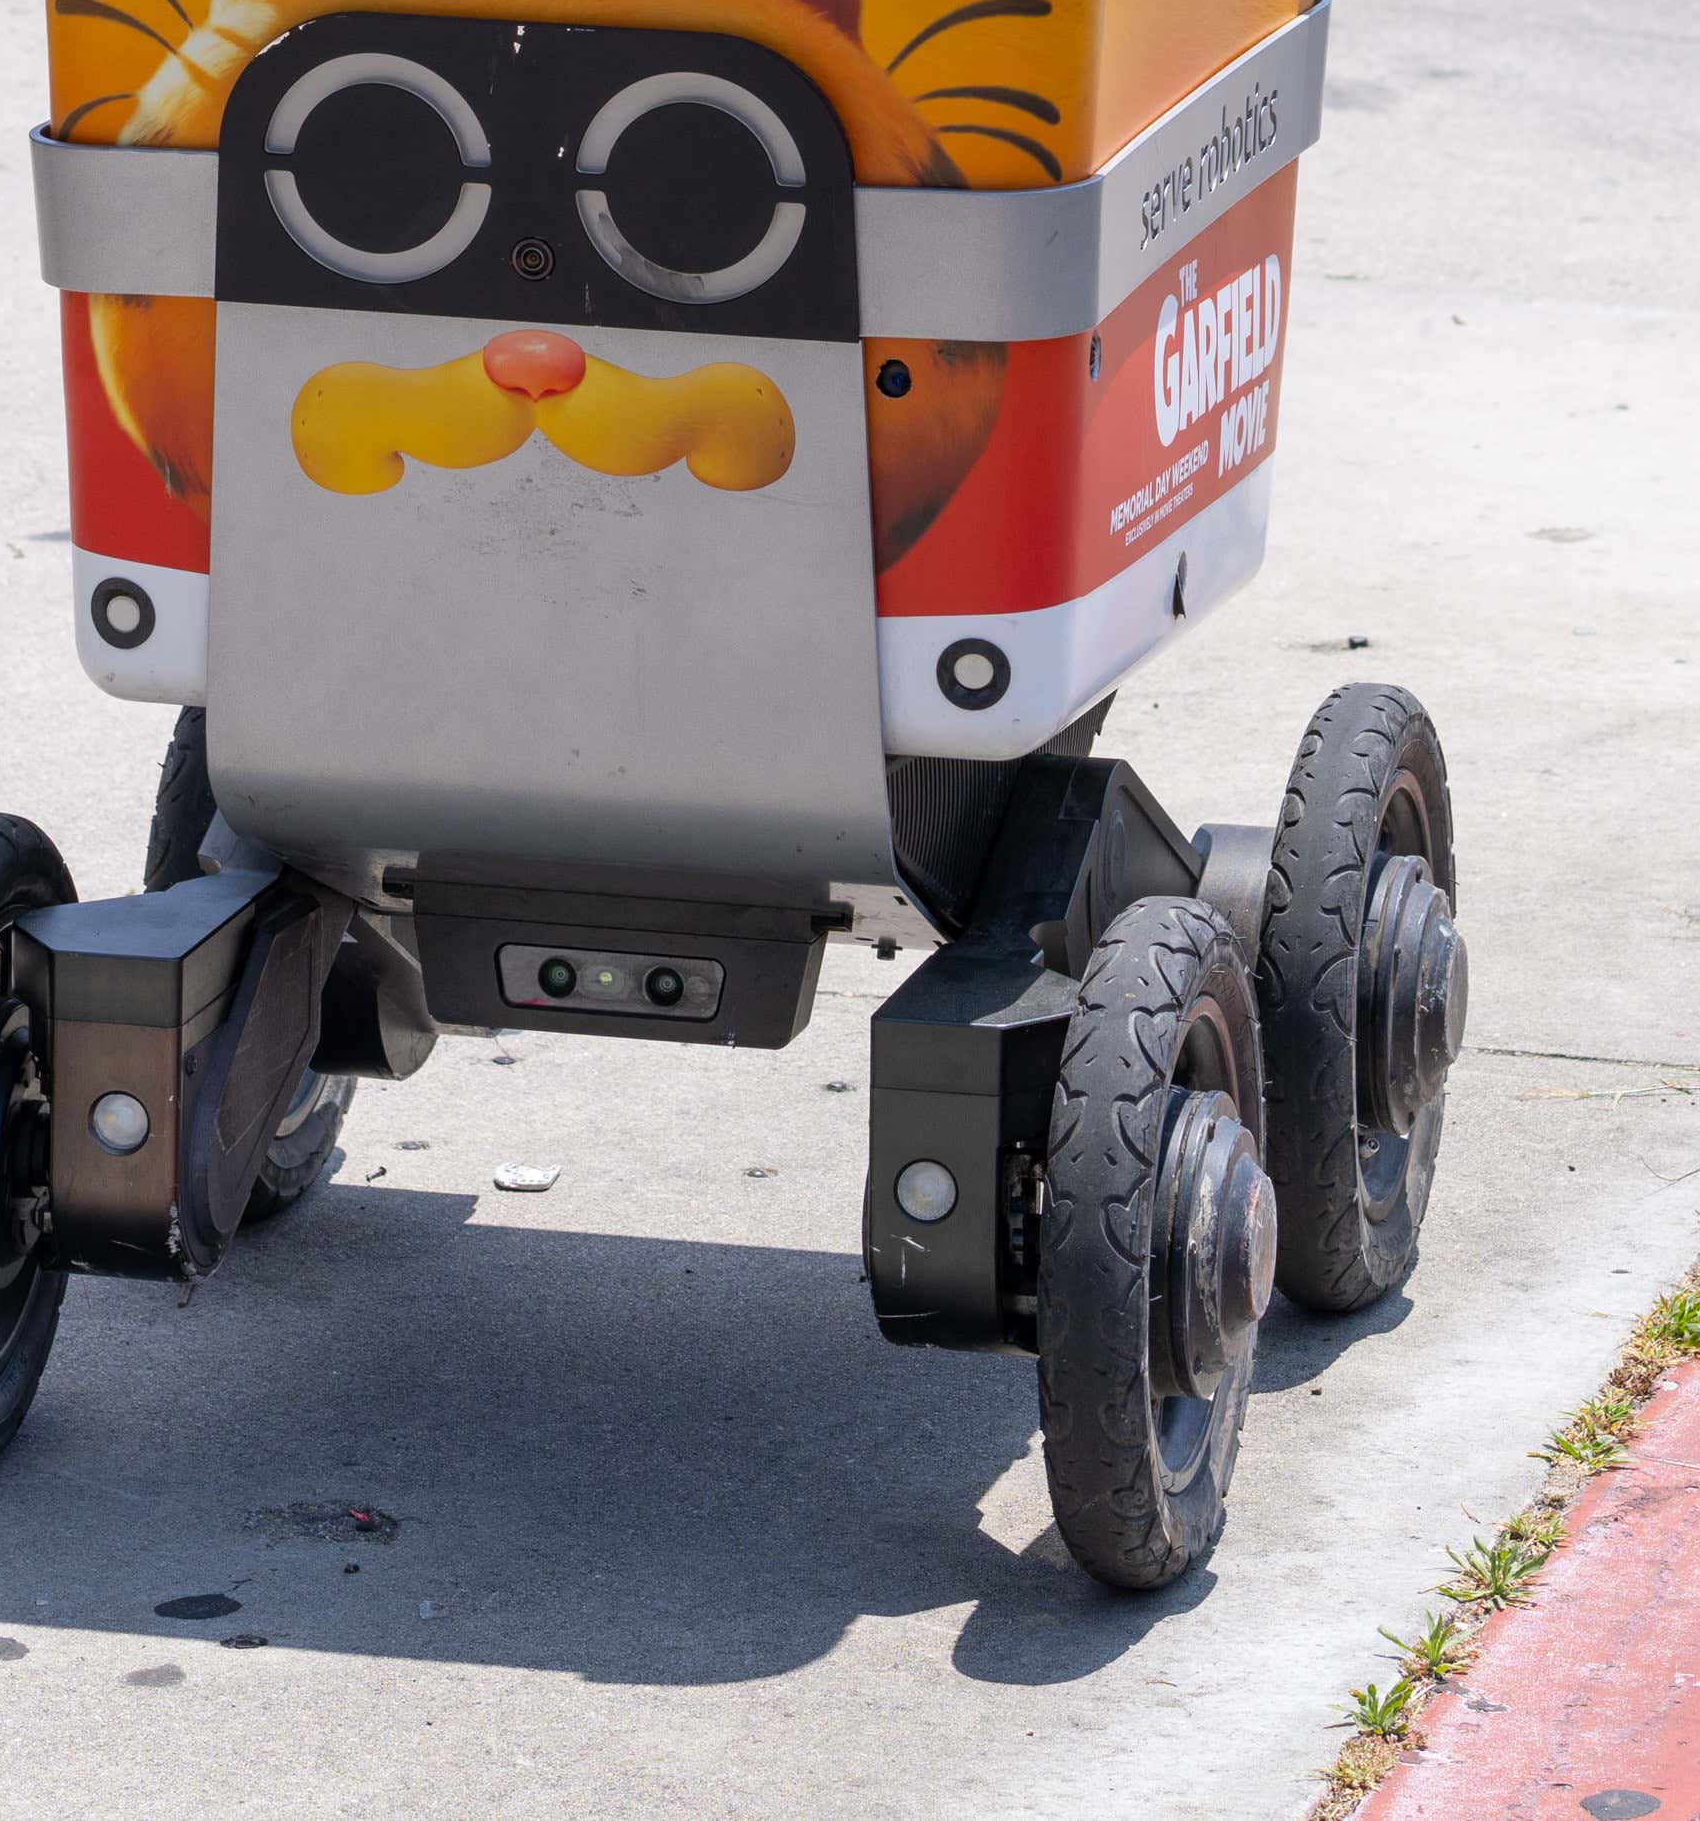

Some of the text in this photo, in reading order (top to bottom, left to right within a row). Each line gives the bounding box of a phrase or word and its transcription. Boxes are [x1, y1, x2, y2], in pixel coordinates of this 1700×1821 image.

[1140, 81, 1278, 251] serve robotics
[1179, 259, 1198, 307] THE
[1154, 253, 1281, 447] GARFIELD
[1218, 379, 1270, 479] MOVIE
[1109, 439, 1209, 535] MEMORIAL DAY WEEKEND
[1125, 514, 1154, 546] EXCLUSIVELY
